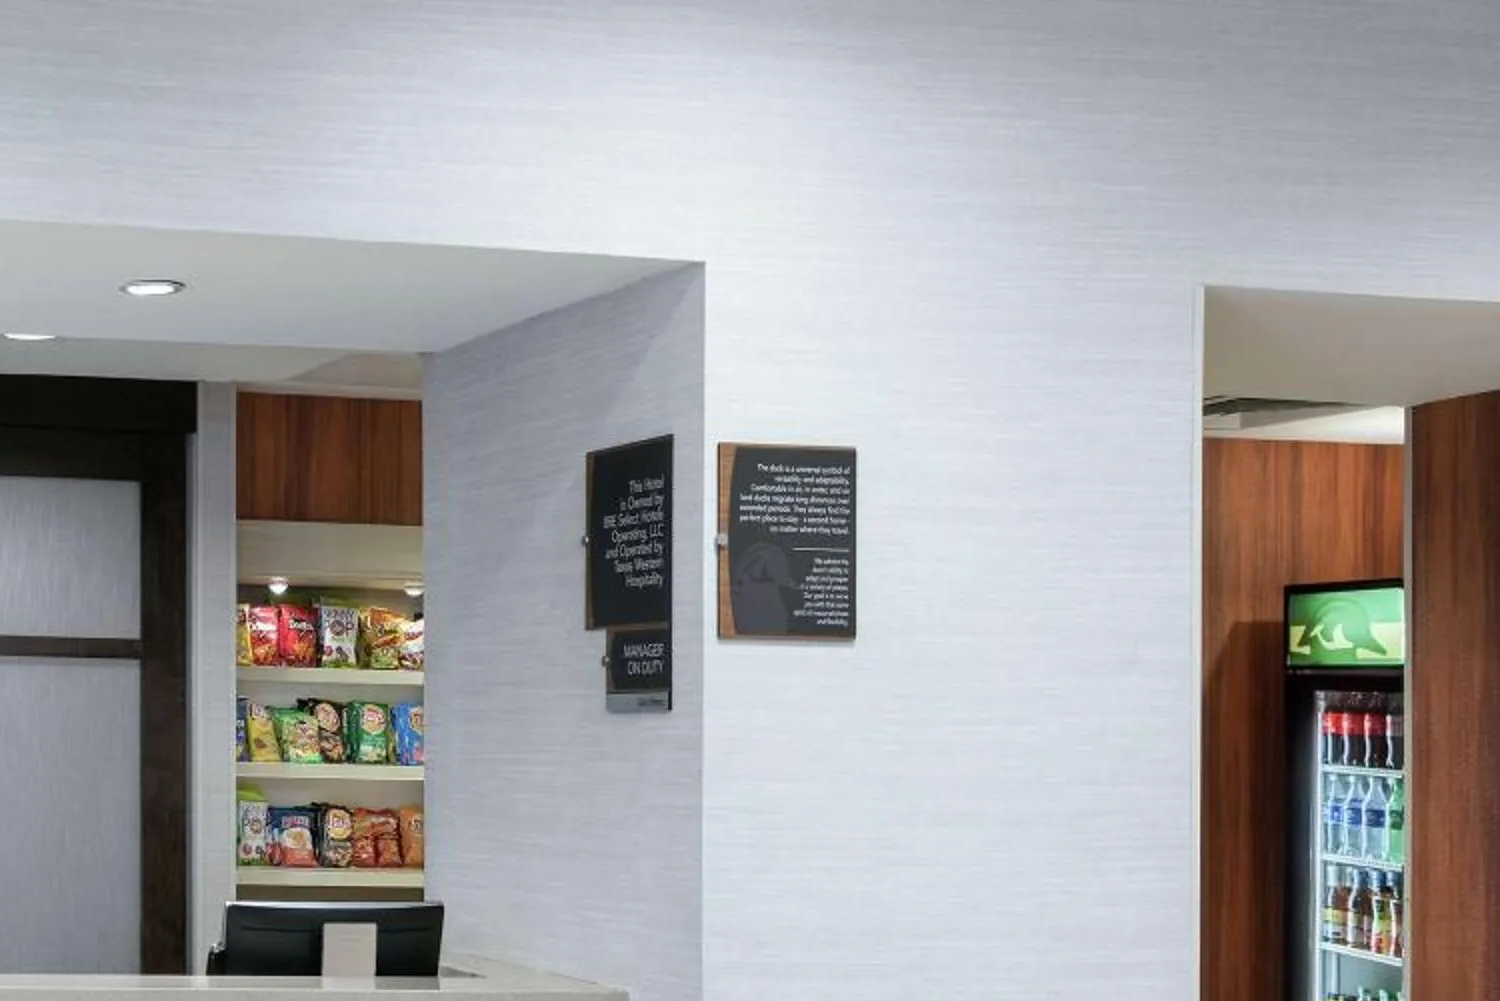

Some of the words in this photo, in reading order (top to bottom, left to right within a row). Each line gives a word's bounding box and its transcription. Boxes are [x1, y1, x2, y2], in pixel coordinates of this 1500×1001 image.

[628, 479, 643, 494] This
[623, 643, 665, 658] MANAGER
[628, 661, 641, 675] ON
[642, 659, 663, 676] DUTY
